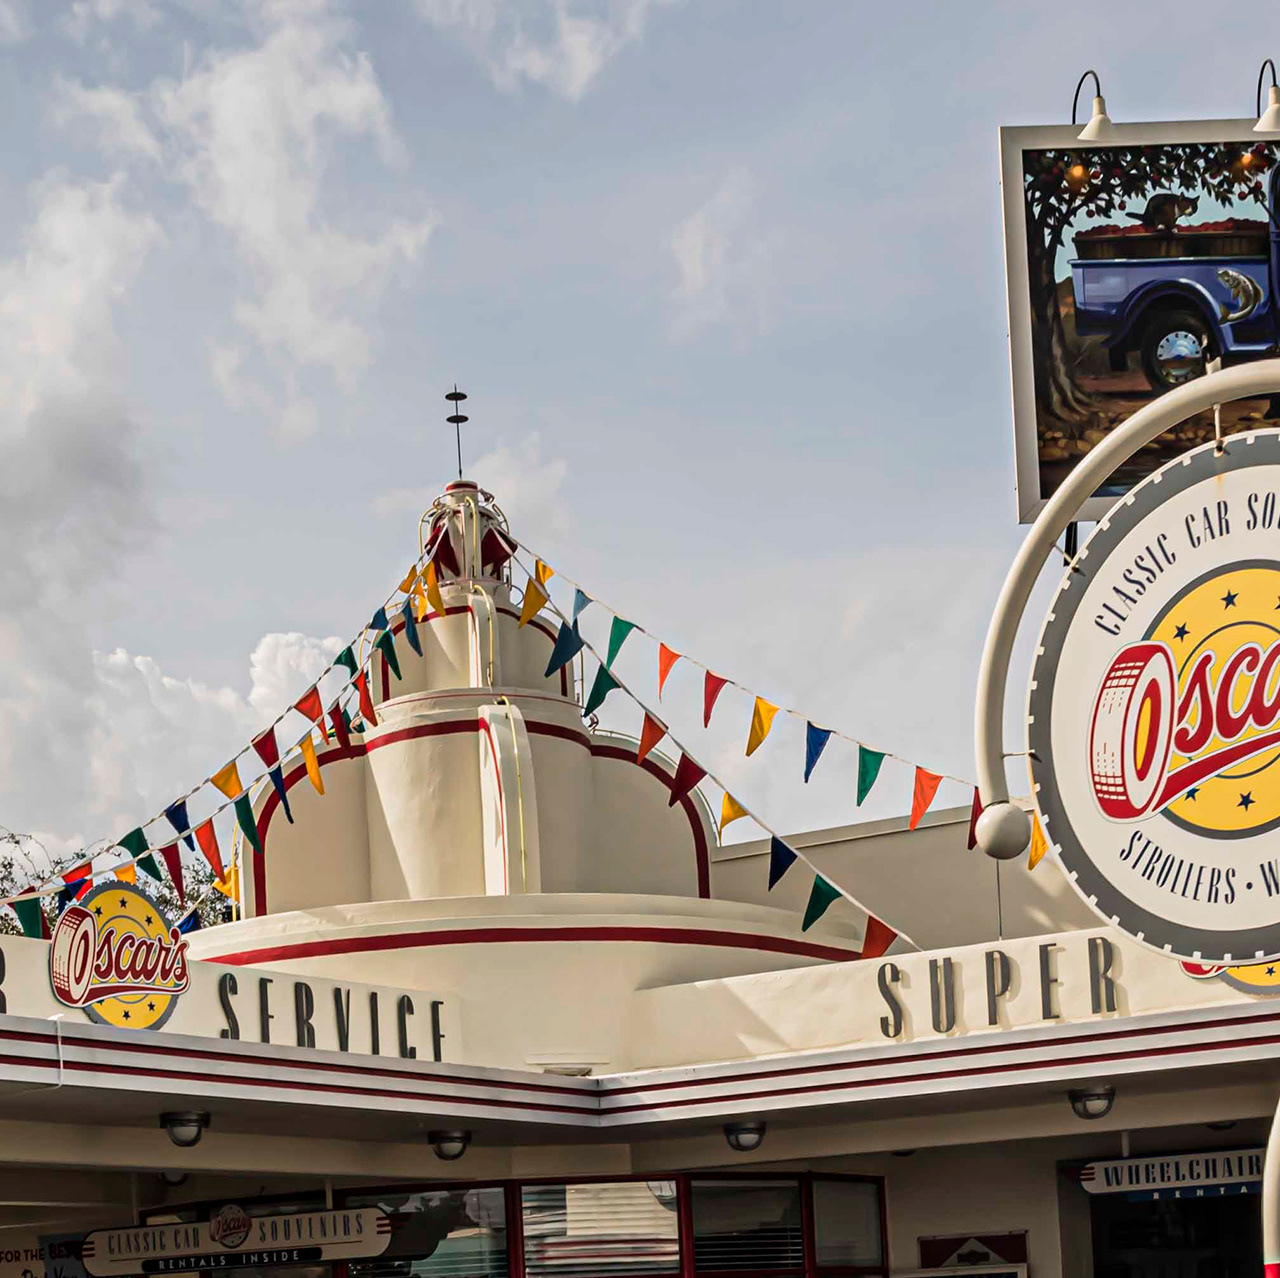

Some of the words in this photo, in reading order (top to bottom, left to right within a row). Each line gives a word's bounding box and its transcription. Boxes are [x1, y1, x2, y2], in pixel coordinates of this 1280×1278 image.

[1094, 533, 1178, 636] CLASSIC
[1184, 500, 1231, 549] CAR
[1118, 829, 1237, 905] STROLLERS
[50, 903, 191, 1008] Oscar's
[877, 936, 1119, 1039] SUPER
[220, 973, 447, 1062] SERVICE
[1103, 1155, 1262, 1187] WHEELCHAIR
[1152, 1185, 1248, 1200] RENTA
[23, 1248, 44, 1261] THE
[108, 1229, 166, 1255] CLASSIC
[174, 1226, 201, 1249] CAR
[259, 1213, 364, 1243] SOUVENIRS
[158, 1255, 226, 1270] RENTALS
[242, 1250, 300, 1264] INSIDE
